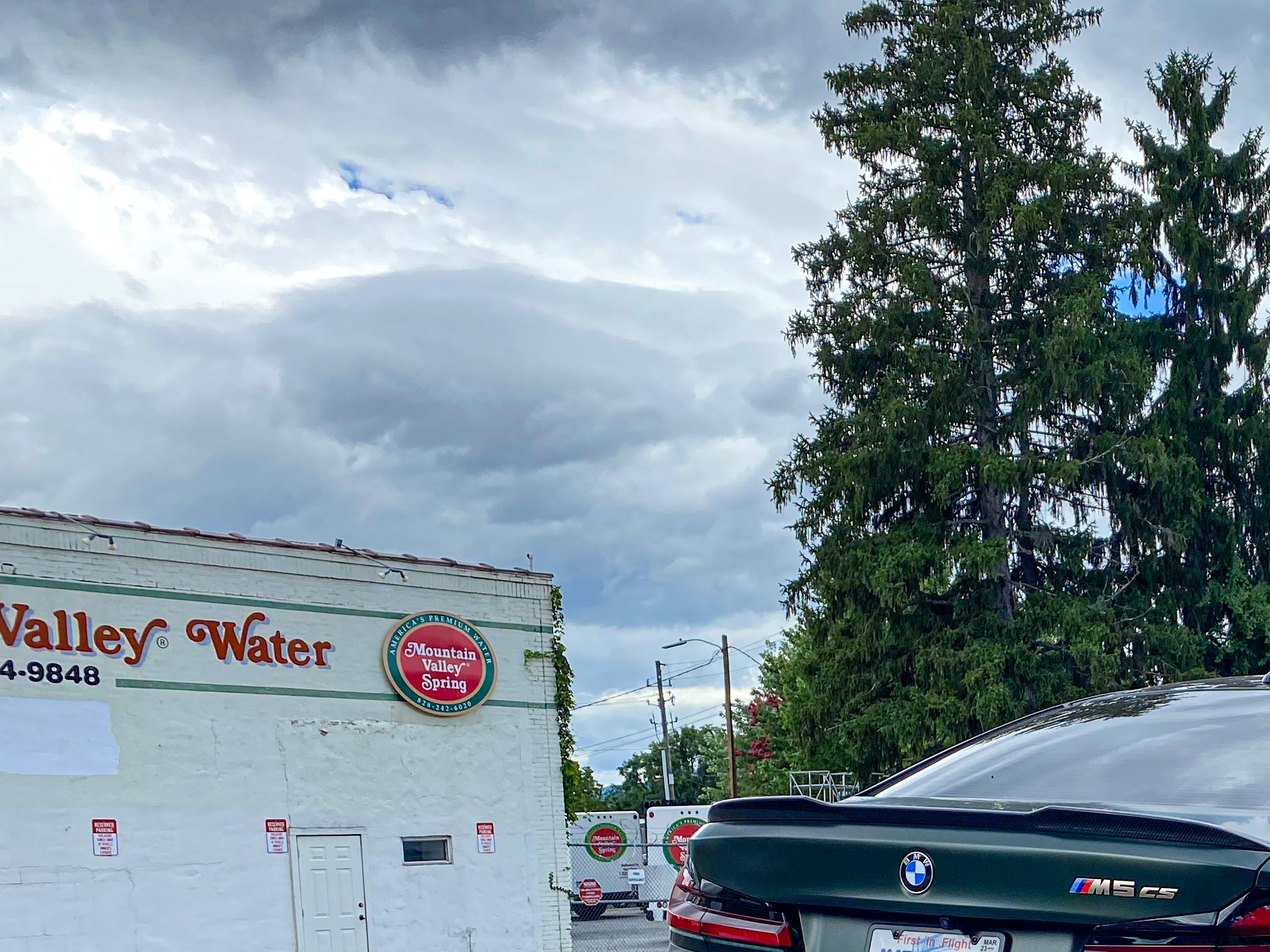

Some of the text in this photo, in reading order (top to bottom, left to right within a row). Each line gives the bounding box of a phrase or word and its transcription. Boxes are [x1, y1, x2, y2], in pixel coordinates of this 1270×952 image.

[185, 611, 333, 667] Water
[389, 614, 492, 665] AMERICA'S PREMIUM WATER
[404, 641, 478, 661] Mountain
[0, 659, 101, 687] 4-9848
[421, 658, 466, 677] Valley
[421, 673, 467, 694] Spring
[903, 853, 931, 868] BMW
[1087, 878, 1179, 900] M5 CS
[896, 934, 921, 946] First
[941, 937, 972, 951] Flight
